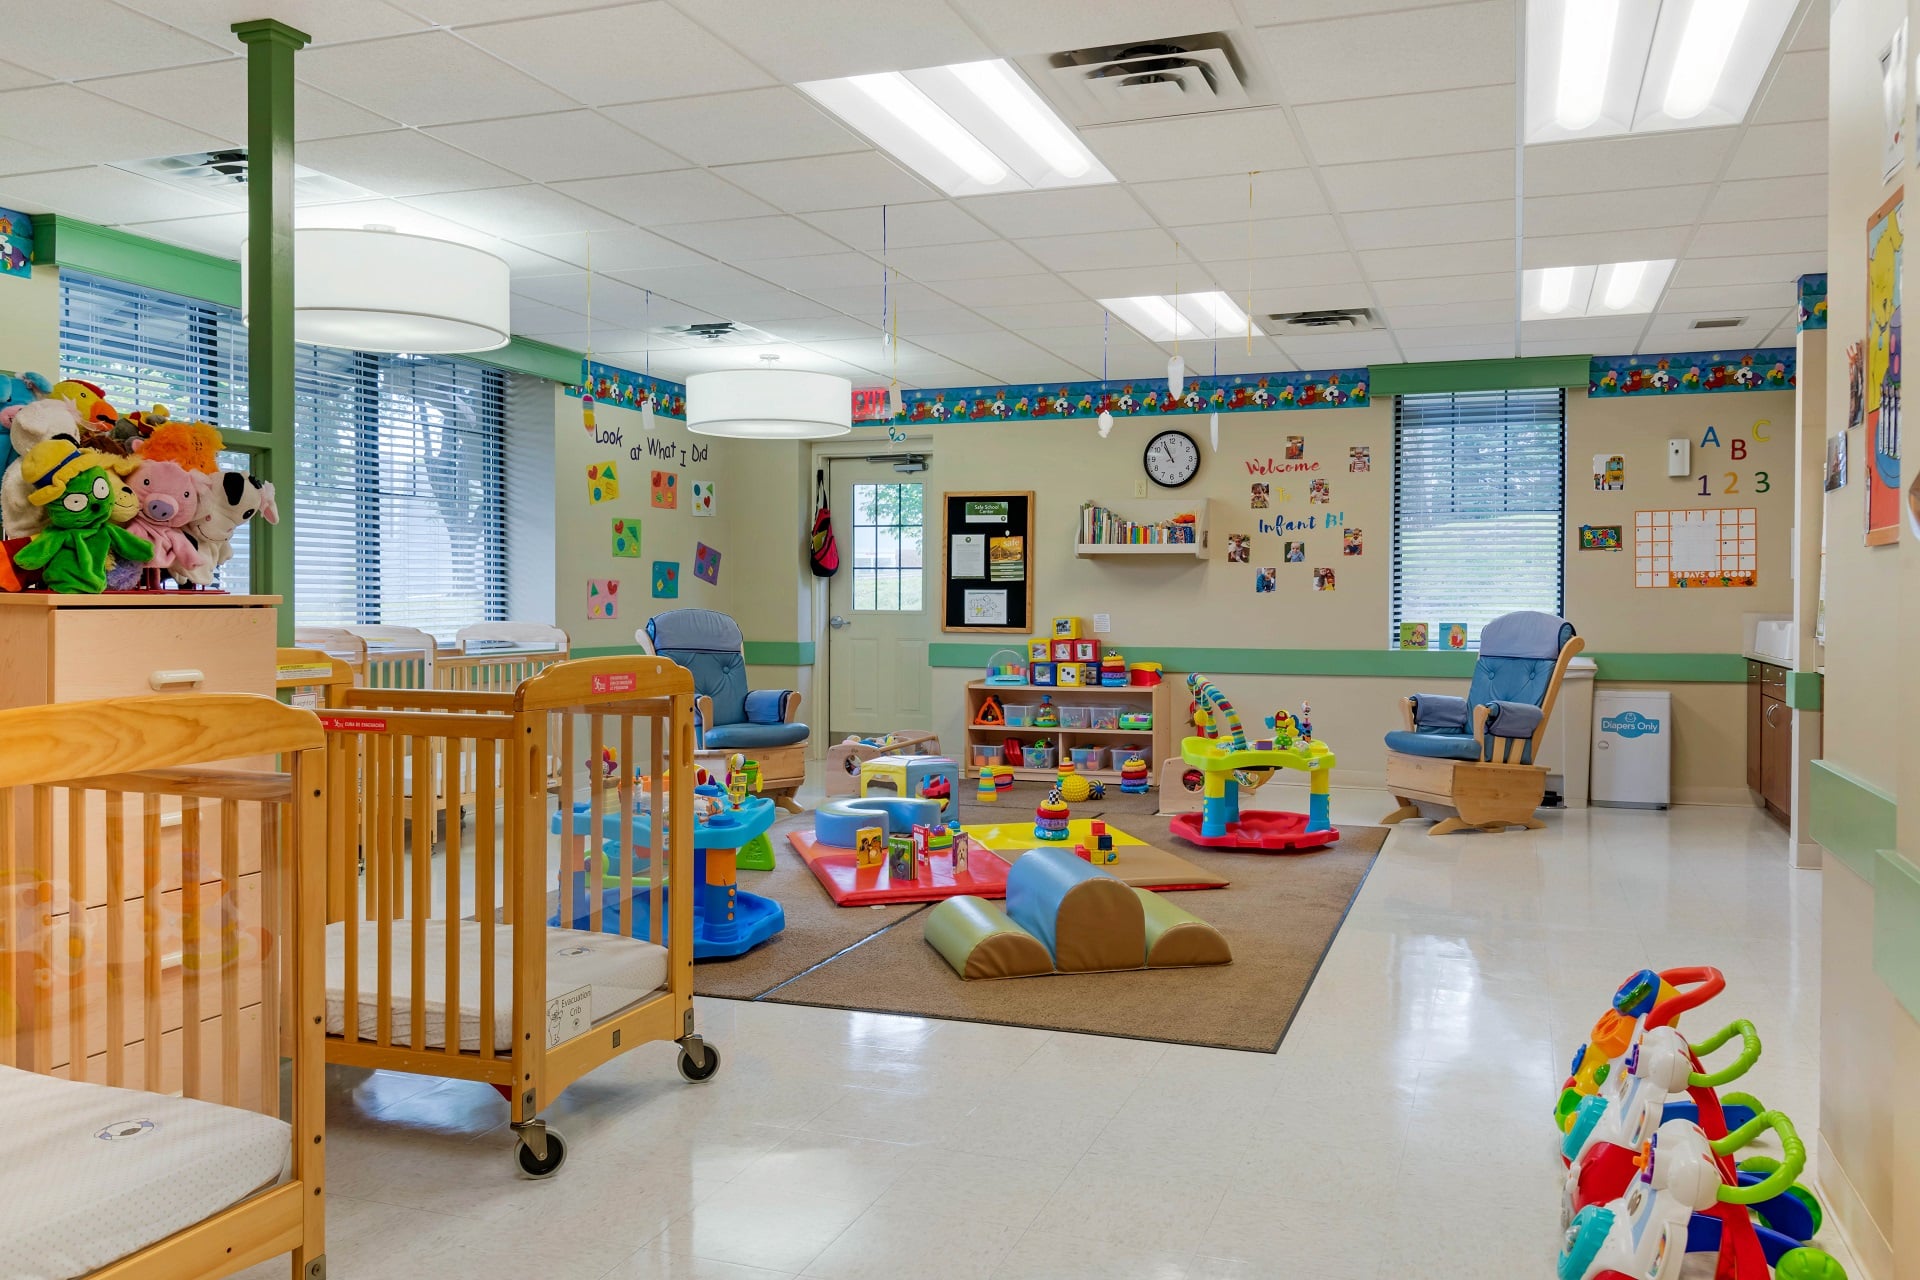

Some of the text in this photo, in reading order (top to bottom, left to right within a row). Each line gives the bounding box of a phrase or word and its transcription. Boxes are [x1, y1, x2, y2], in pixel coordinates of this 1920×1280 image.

[852, 389, 886, 416] EXIT
[595, 424, 709, 467] Look at What I Did
[1700, 419, 1772, 460] A B C
[1245, 458, 1320, 476] Welcome
[1276, 487, 1291, 502] To
[1698, 471, 1770, 496] 1 2 3
[1259, 512, 1344, 536] Infant B!
[1672, 571, 1682, 579] 30
[1684, 570, 1705, 578] DAYS
[1602, 720, 1658, 732] Diapers Only
[561, 990, 591, 1017] Evacuation Crib
